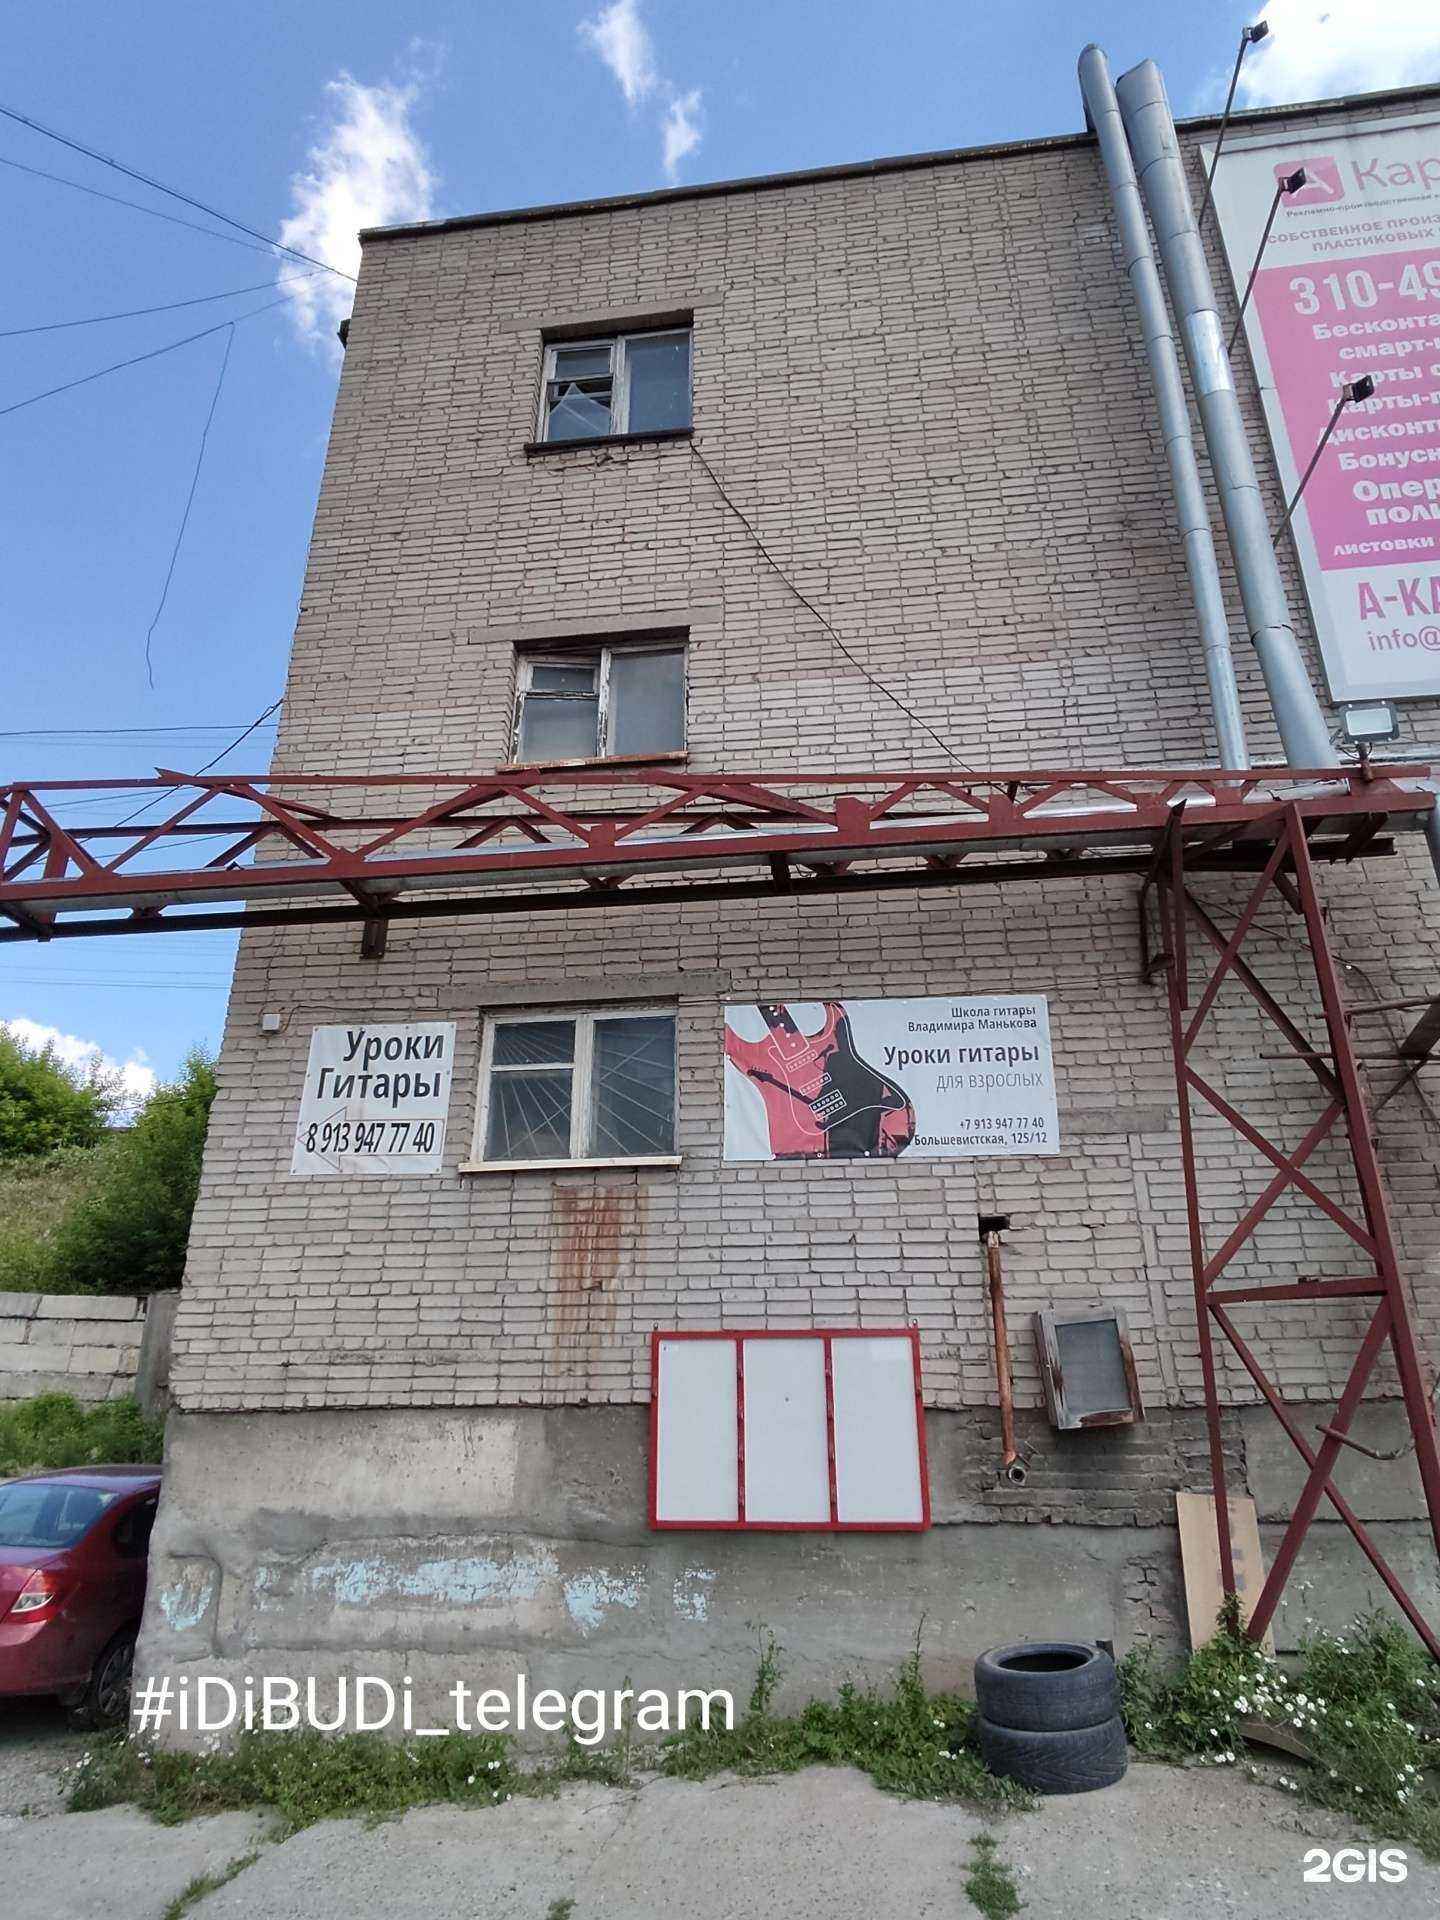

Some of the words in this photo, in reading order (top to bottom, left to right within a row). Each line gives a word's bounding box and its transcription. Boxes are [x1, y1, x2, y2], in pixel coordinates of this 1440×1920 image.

[1351, 158, 1440, 190] Кар
[1268, 221, 1383, 244] СОБСТВЕННОЕ
[1312, 228, 1434, 252] ПЛАСТИКОВЫХ
[1317, 419, 1440, 446] Дисконт
[1333, 536, 1434, 556] листовки
[1367, 625, 1440, 651] info@
[951, 1007, 990, 1018] Школа
[994, 1006, 1036, 1020] гитары
[908, 1021, 975, 1033] Владимира
[978, 1018, 1037, 1030] Манькова
[343, 1031, 444, 1071] Уроки
[884, 1046, 950, 1070] Уроки
[959, 1045, 1039, 1067] гитары
[317, 1067, 441, 1108] Гитары
[937, 1075, 963, 1093] для
[969, 1073, 1044, 1093] взрослых
[960, 1119, 971, 1130] +7
[974, 1119, 992, 1129] 913
[996, 1118, 1013, 1129] 947
[1016, 1118, 1028, 1129] 77
[1032, 1117, 1044, 1128] 40
[306, 1123, 318, 1153] 8
[321, 1123, 350, 1153] 913
[354, 1123, 385, 1153] 947
[388, 1123, 410, 1153] 77
[413, 1122, 435, 1153] 40
[914, 1134, 1008, 1147] Большевистская,
[1012, 1132, 1048, 1144] 125/12
